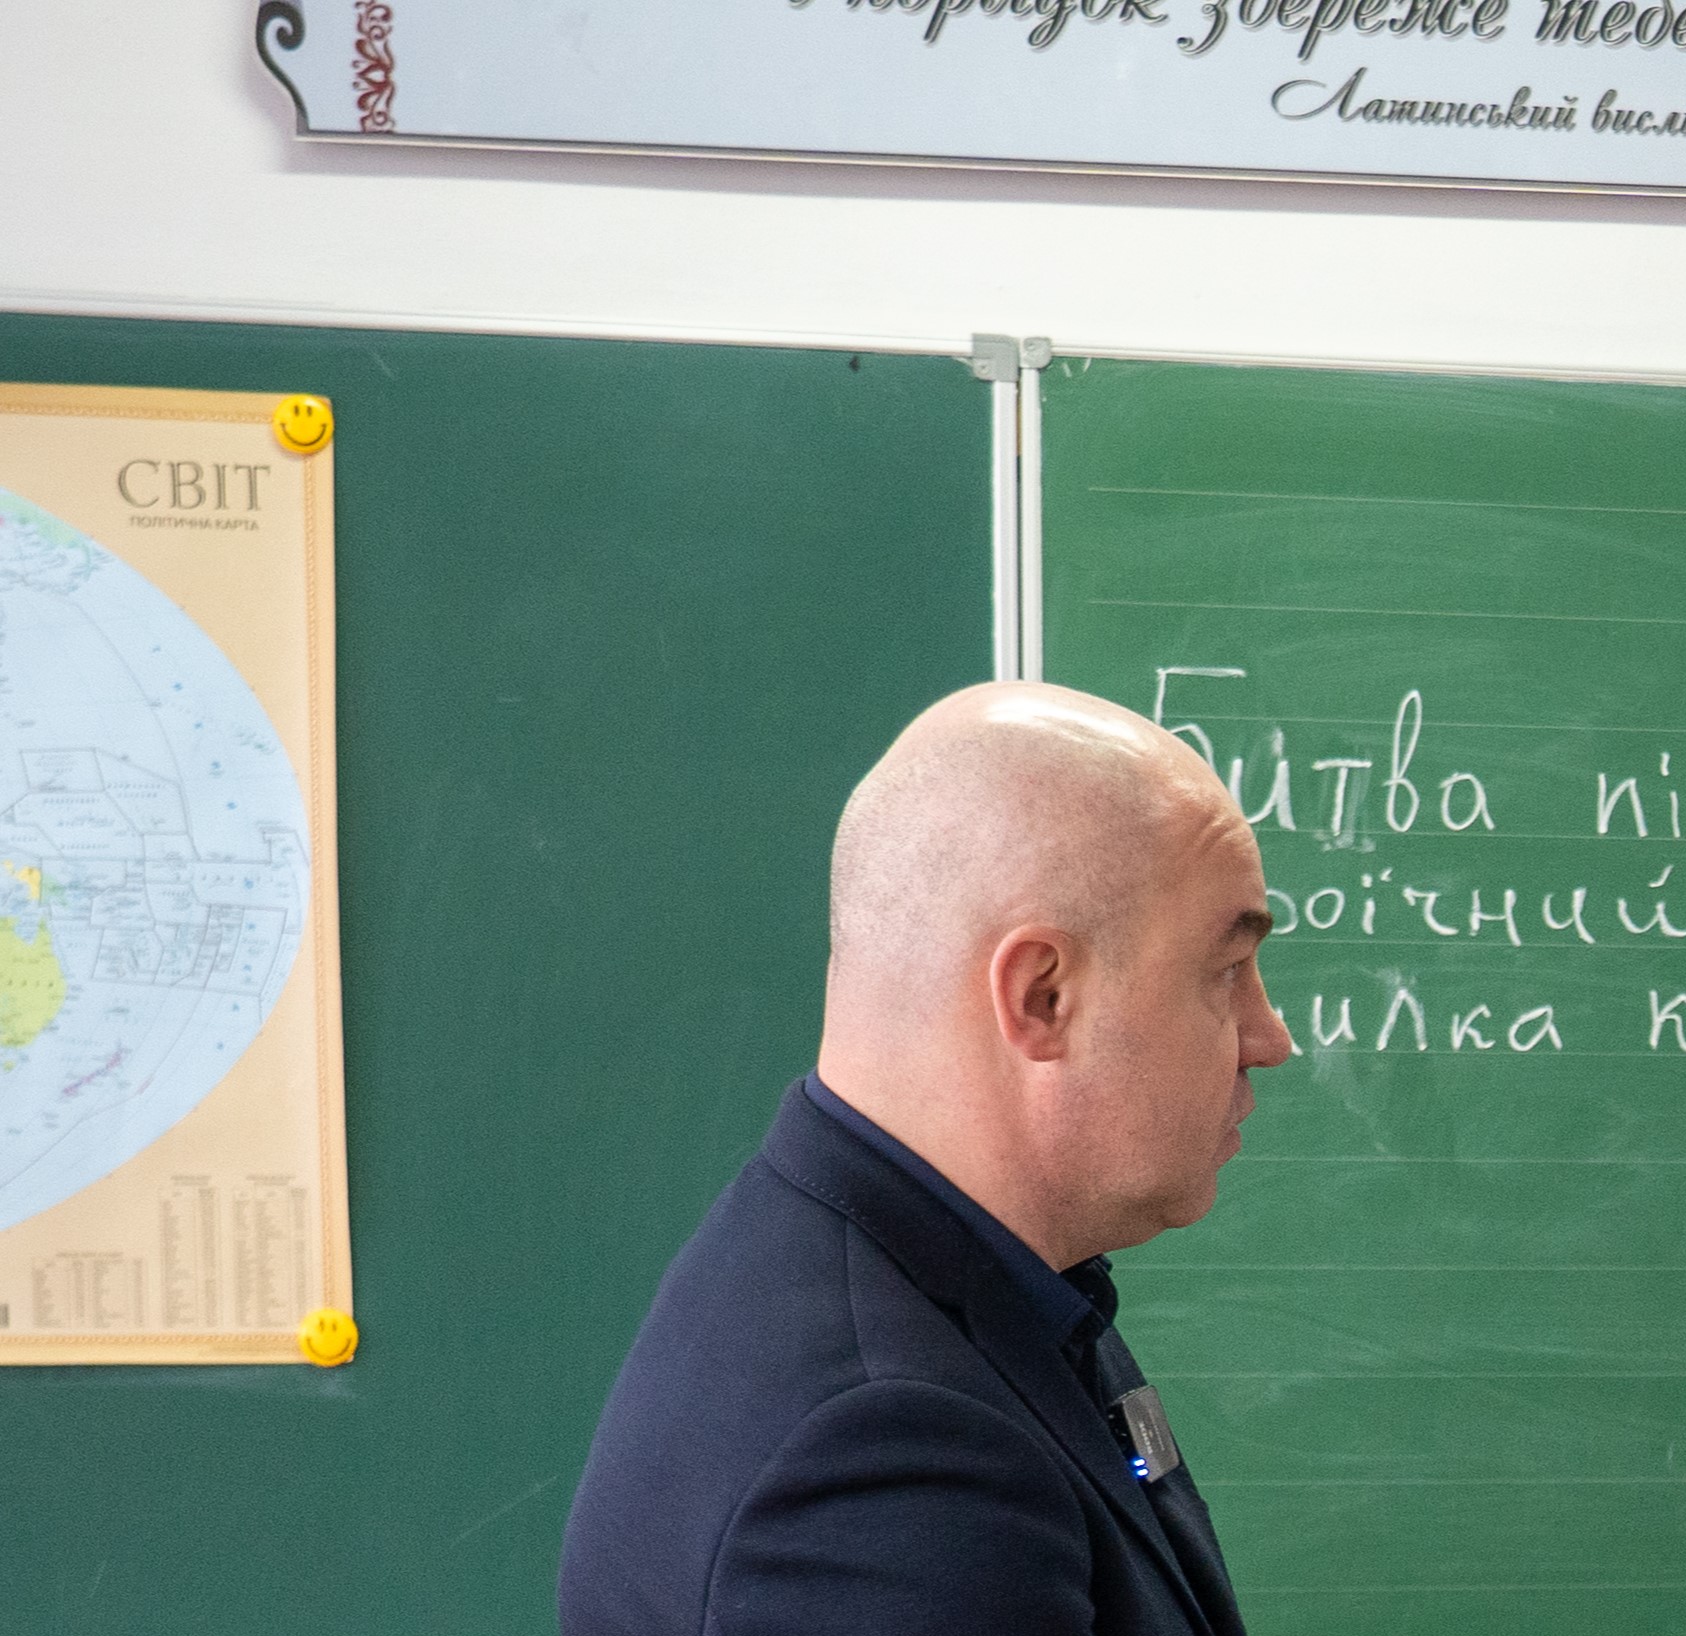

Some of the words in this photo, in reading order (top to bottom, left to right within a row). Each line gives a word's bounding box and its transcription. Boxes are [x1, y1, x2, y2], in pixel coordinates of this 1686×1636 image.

[1270, 66, 1577, 131] Латинський
[117, 458, 271, 511] СВІТ
[130, 516, 210, 530] ПОЛІТИЧНА
[215, 518, 259, 531] КАРТА
[1155, 666, 1495, 833] Битва
[1275, 987, 1563, 1057] илка
